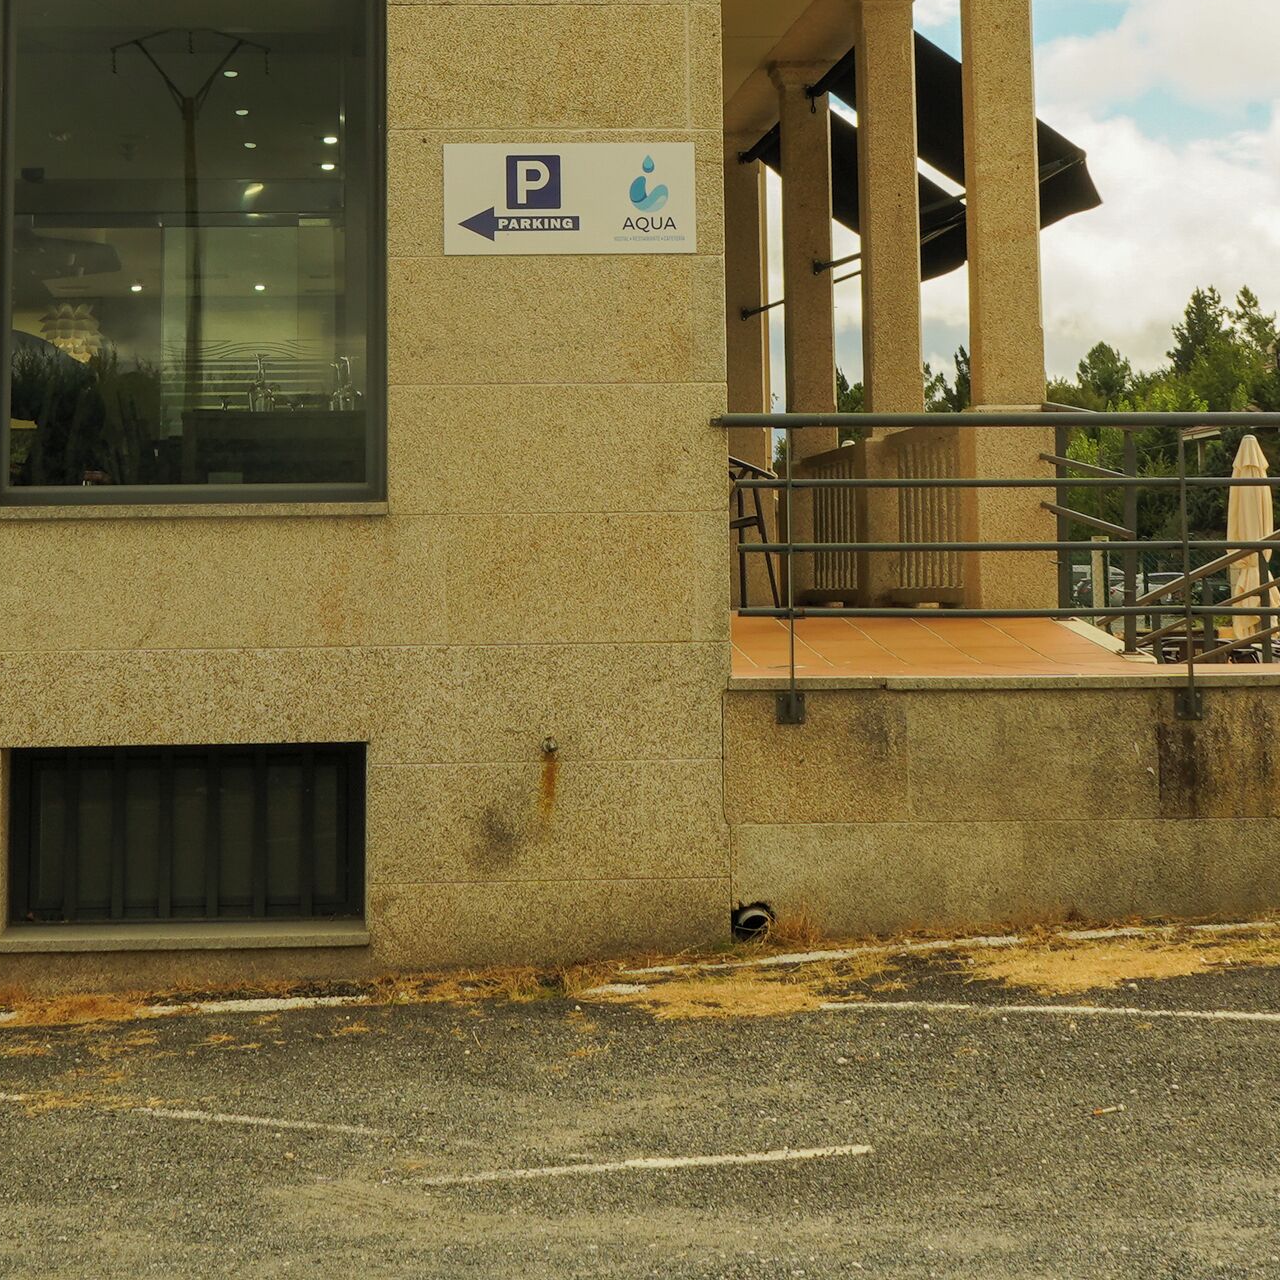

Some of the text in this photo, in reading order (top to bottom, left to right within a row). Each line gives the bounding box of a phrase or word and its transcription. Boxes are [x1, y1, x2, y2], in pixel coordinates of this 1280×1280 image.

[516, 160, 550, 204] P
[497, 218, 574, 230] PARKING
[622, 216, 677, 233] AQUA
